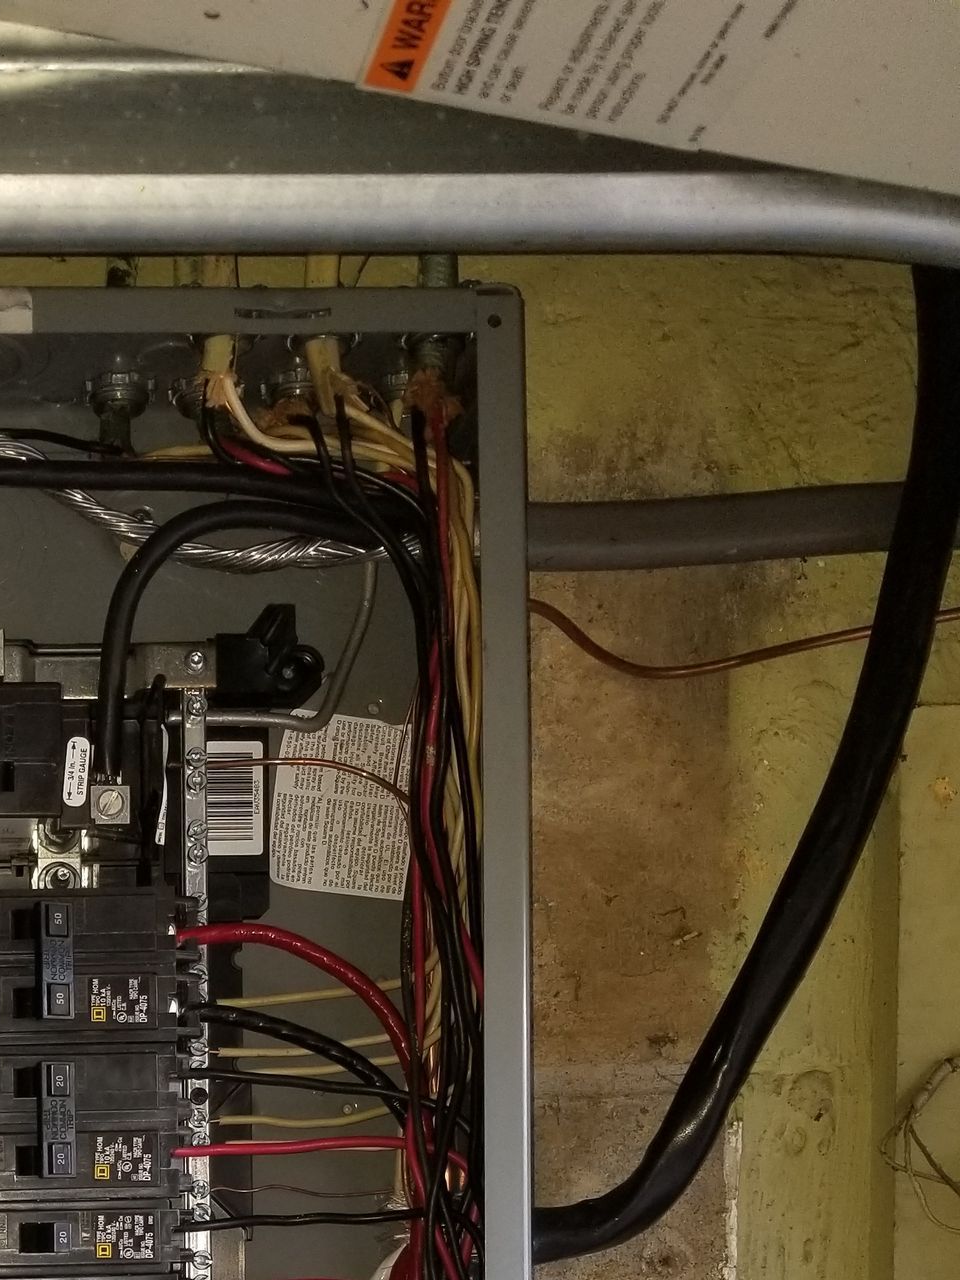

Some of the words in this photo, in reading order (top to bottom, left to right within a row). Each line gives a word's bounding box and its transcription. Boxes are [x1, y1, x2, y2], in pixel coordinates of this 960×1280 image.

[79, 748, 88, 773] GAUGE
[76, 774, 84, 796] STRIP
[54, 912, 62, 925] 50
[56, 992, 65, 1005] 50
[139, 994, 148, 1023] DP-4075
[56, 1075, 65, 1087] 20
[57, 1153, 65, 1165] 20
[143, 1153, 152, 1181] DP-4075
[59, 1231, 68, 1244] 20
[145, 1232, 154, 1259] DP-4075
